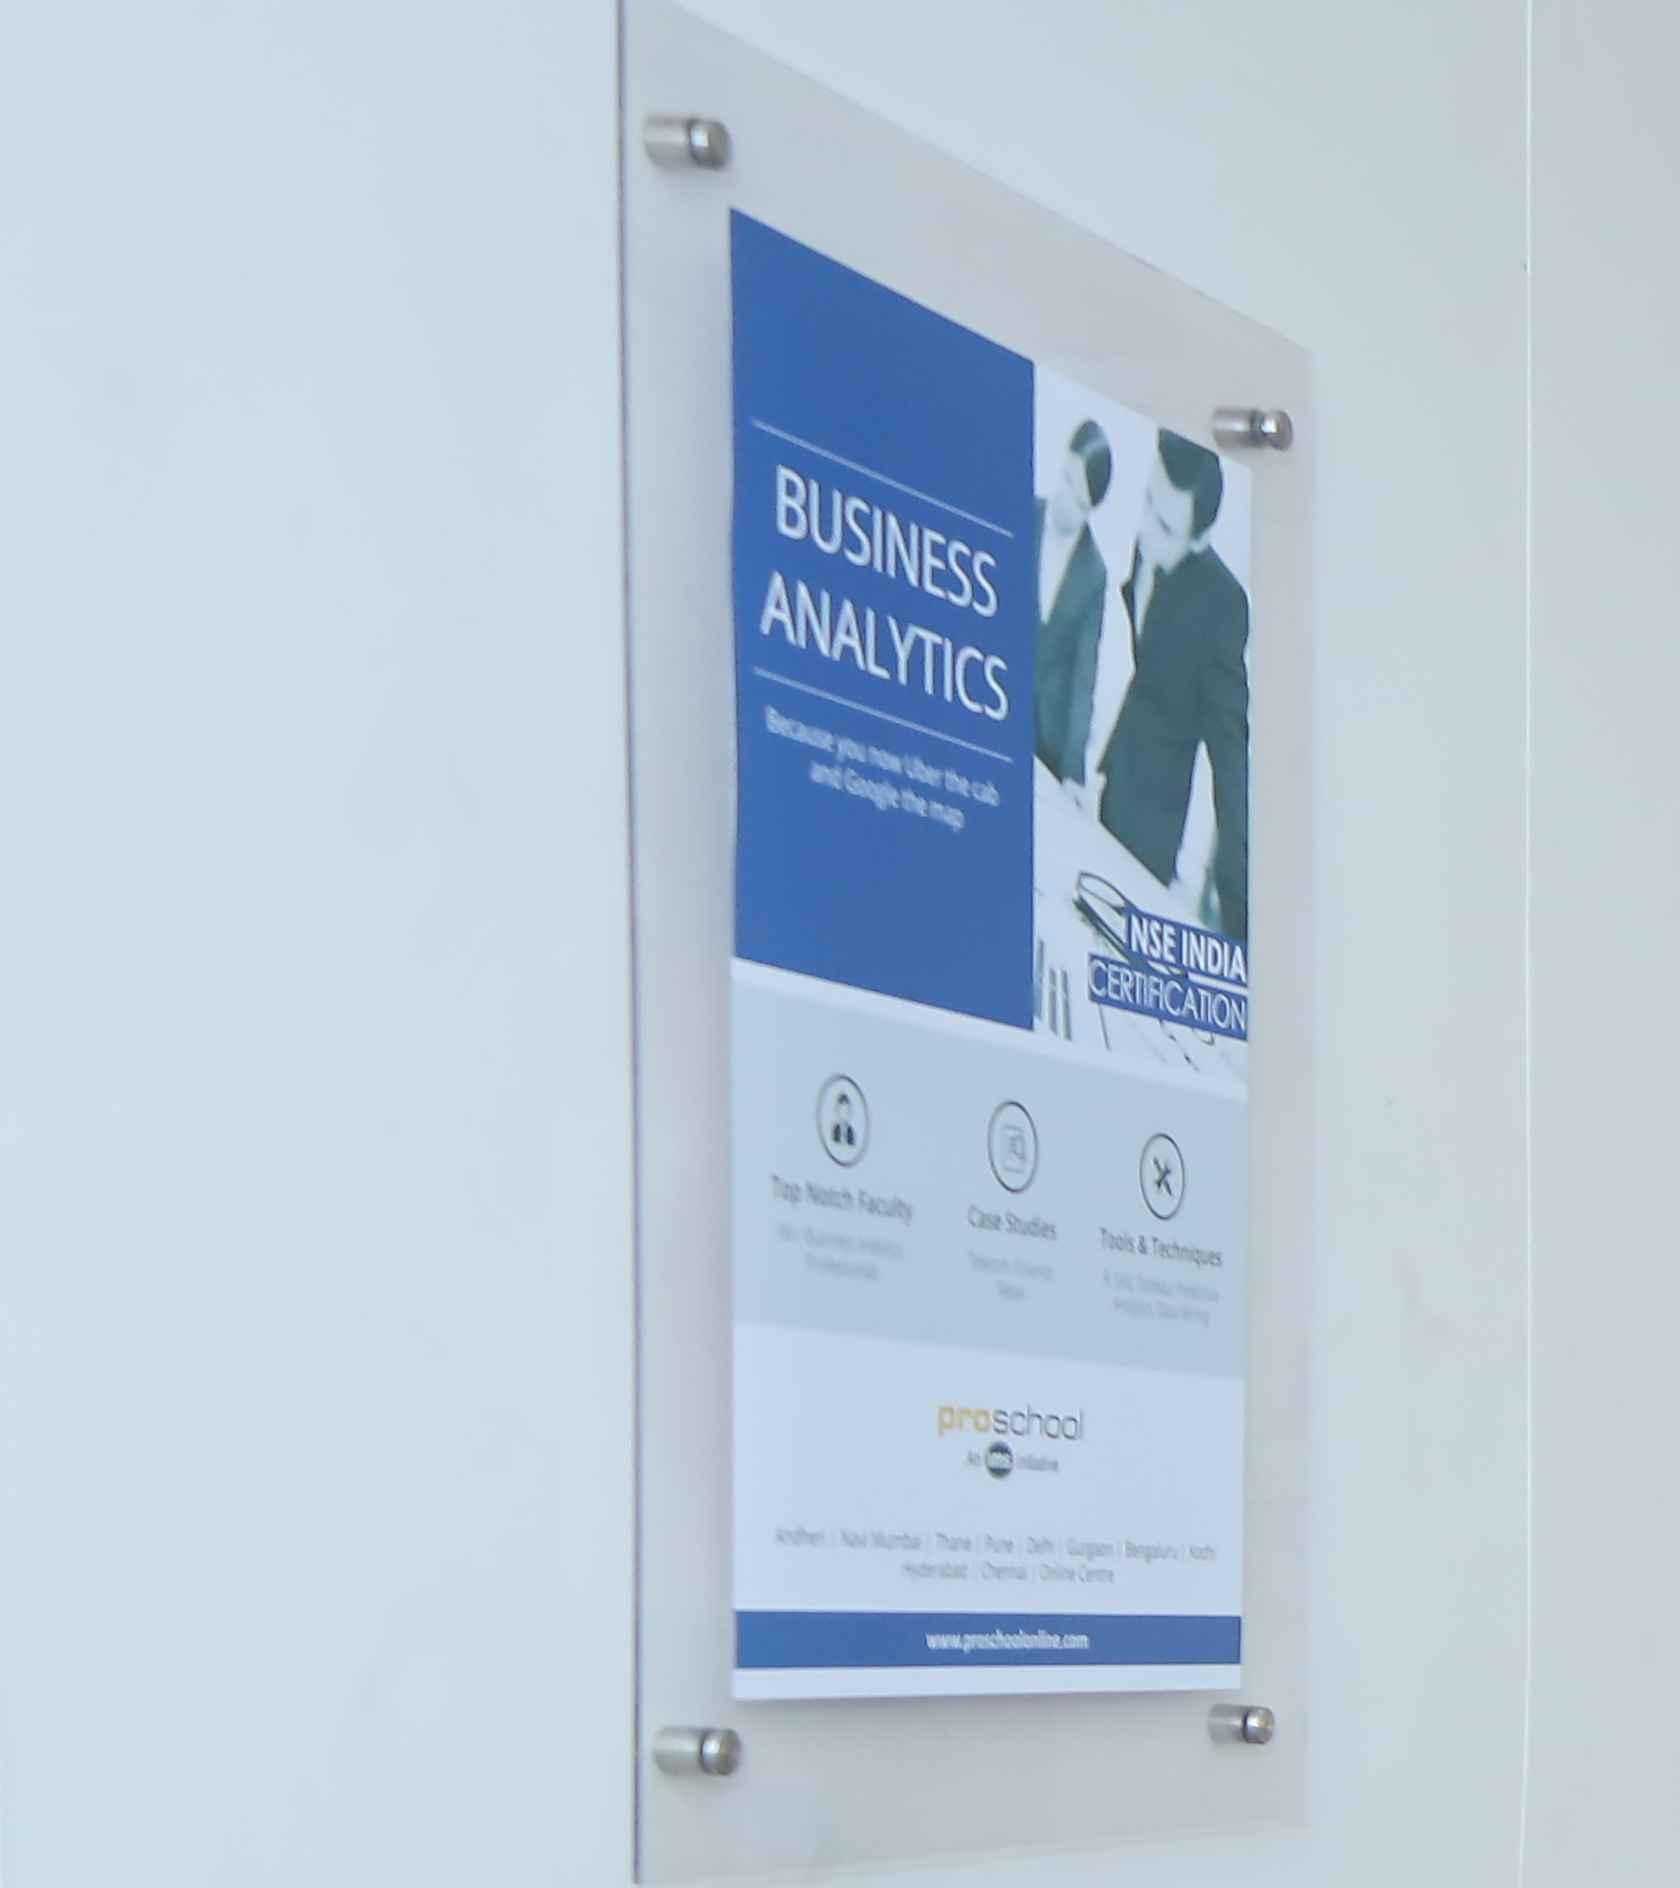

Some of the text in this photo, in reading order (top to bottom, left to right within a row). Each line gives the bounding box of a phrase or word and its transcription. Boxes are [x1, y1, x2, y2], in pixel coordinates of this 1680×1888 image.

[775, 463, 998, 618] BUSINESS
[760, 569, 1009, 721] ANALYTICS
[765, 704, 835, 752] Because
[836, 737, 868, 763] you
[945, 768, 971, 798] the
[972, 780, 999, 807] cab
[810, 760, 965, 833] and Google the map
[1130, 913, 1247, 983] NSE INDIA
[1089, 958, 1246, 1031] CERTIFICATION
[771, 1175, 913, 1227] Top Notch Faculty
[967, 1204, 1057, 1240] Case Studies
[1099, 1226, 1223, 1268] Tools & Techniques
[938, 1402, 1084, 1440] proschool
[925, 1628, 1089, 1654] www.proschoolonline.com
